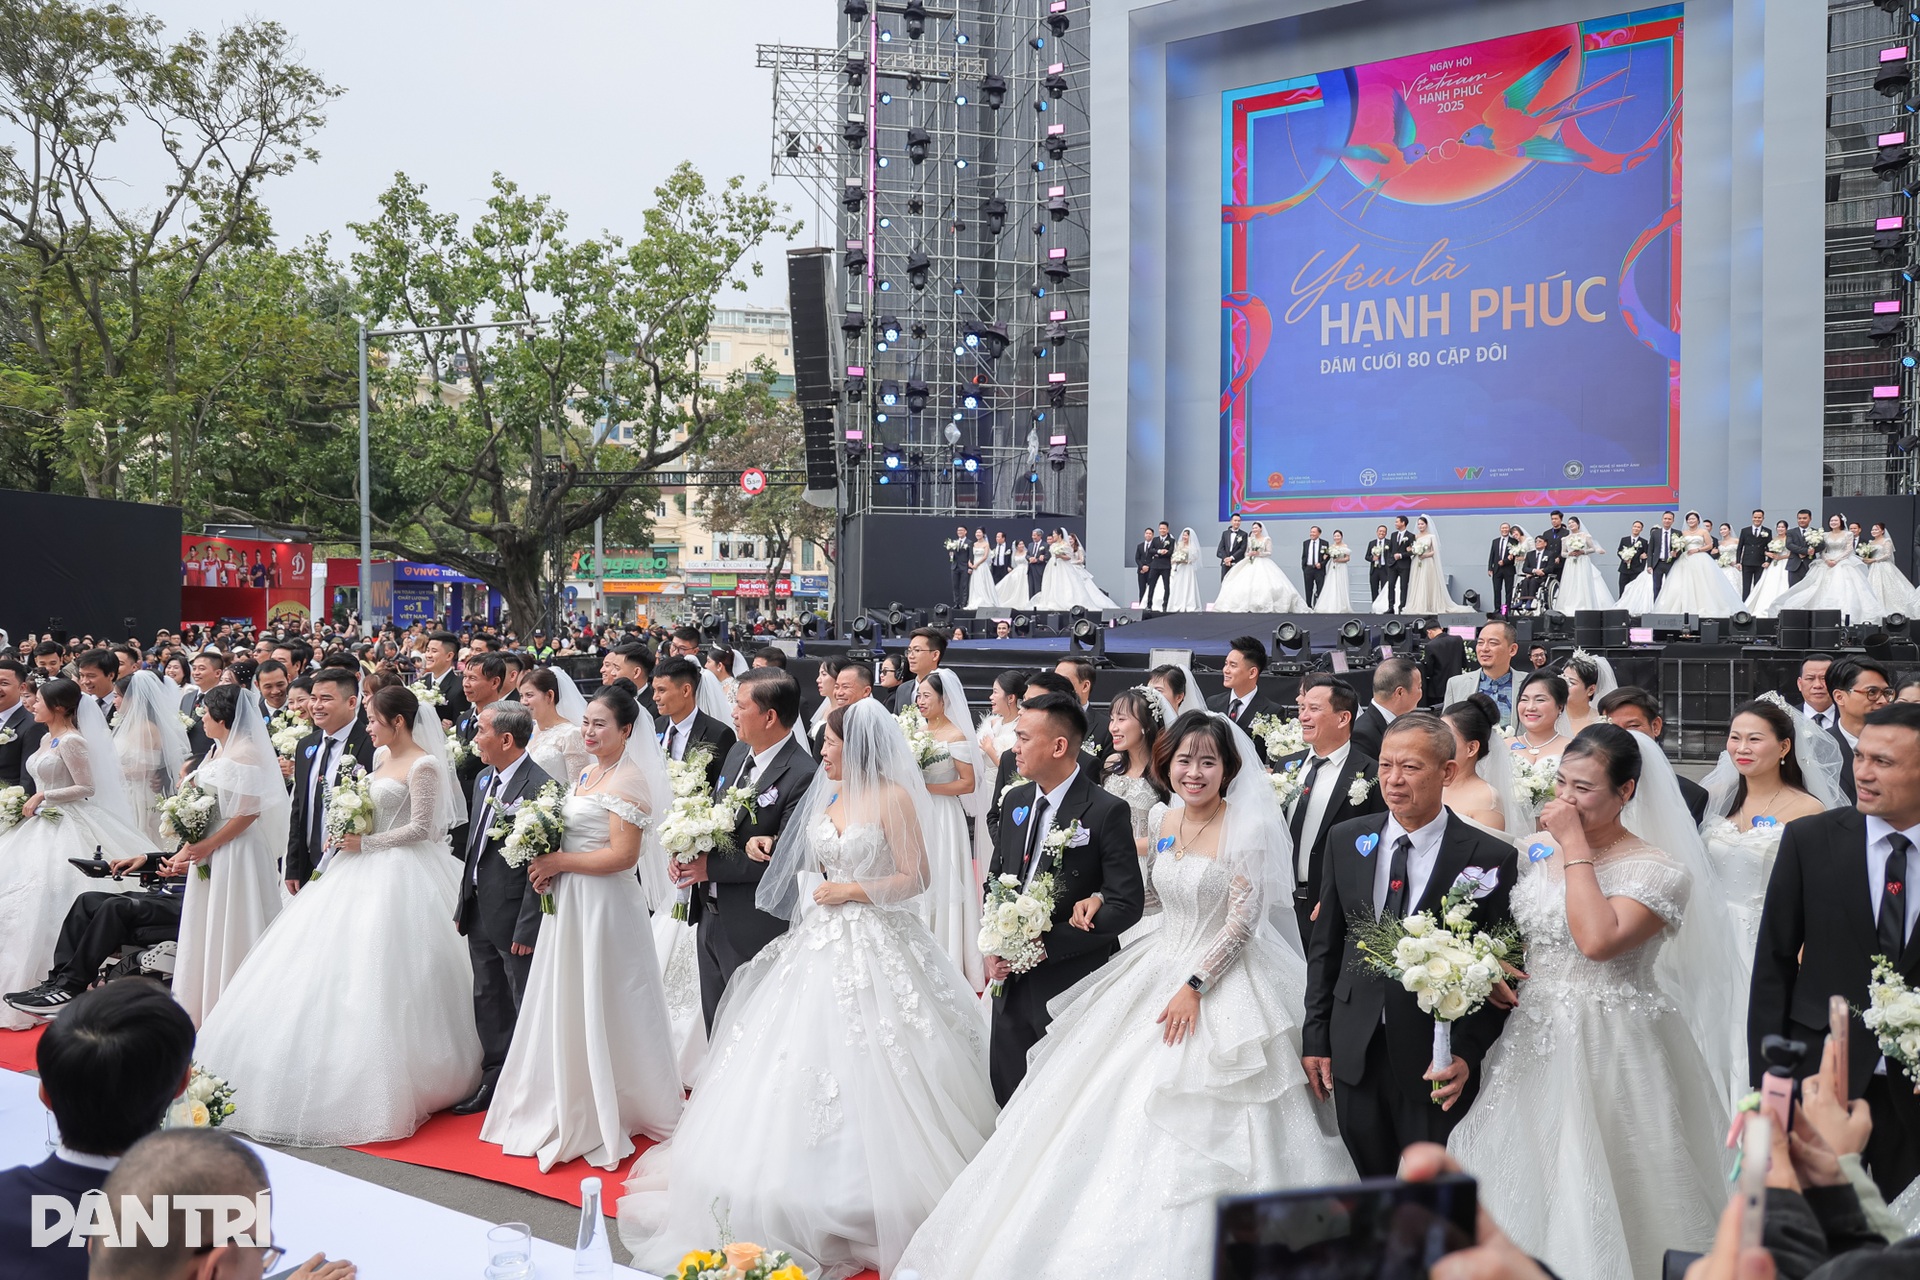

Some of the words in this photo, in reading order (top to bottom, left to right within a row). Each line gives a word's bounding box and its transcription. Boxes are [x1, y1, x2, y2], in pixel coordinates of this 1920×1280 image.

[1437, 100, 1465, 114] 2025
[1285, 243, 1413, 324] Yêu
[1411, 237, 1471, 287] là
[1320, 292, 1450, 348] HẠNH
[1470, 270, 1607, 333] PHÚC
[1361, 350, 1401, 371] CƯỚI
[1407, 351, 1431, 368] 80
[1436, 346, 1470, 367] CẶP
[1476, 342, 1507, 362] ĐÔI
[1454, 465, 1485, 480] VTV
[578, 553, 667, 574] Kangaroo
[413, 568, 440, 577] VNVC
[416, 601, 423, 612] 1
[1018, 811, 1024, 821] 7
[1363, 839, 1372, 852] 71
